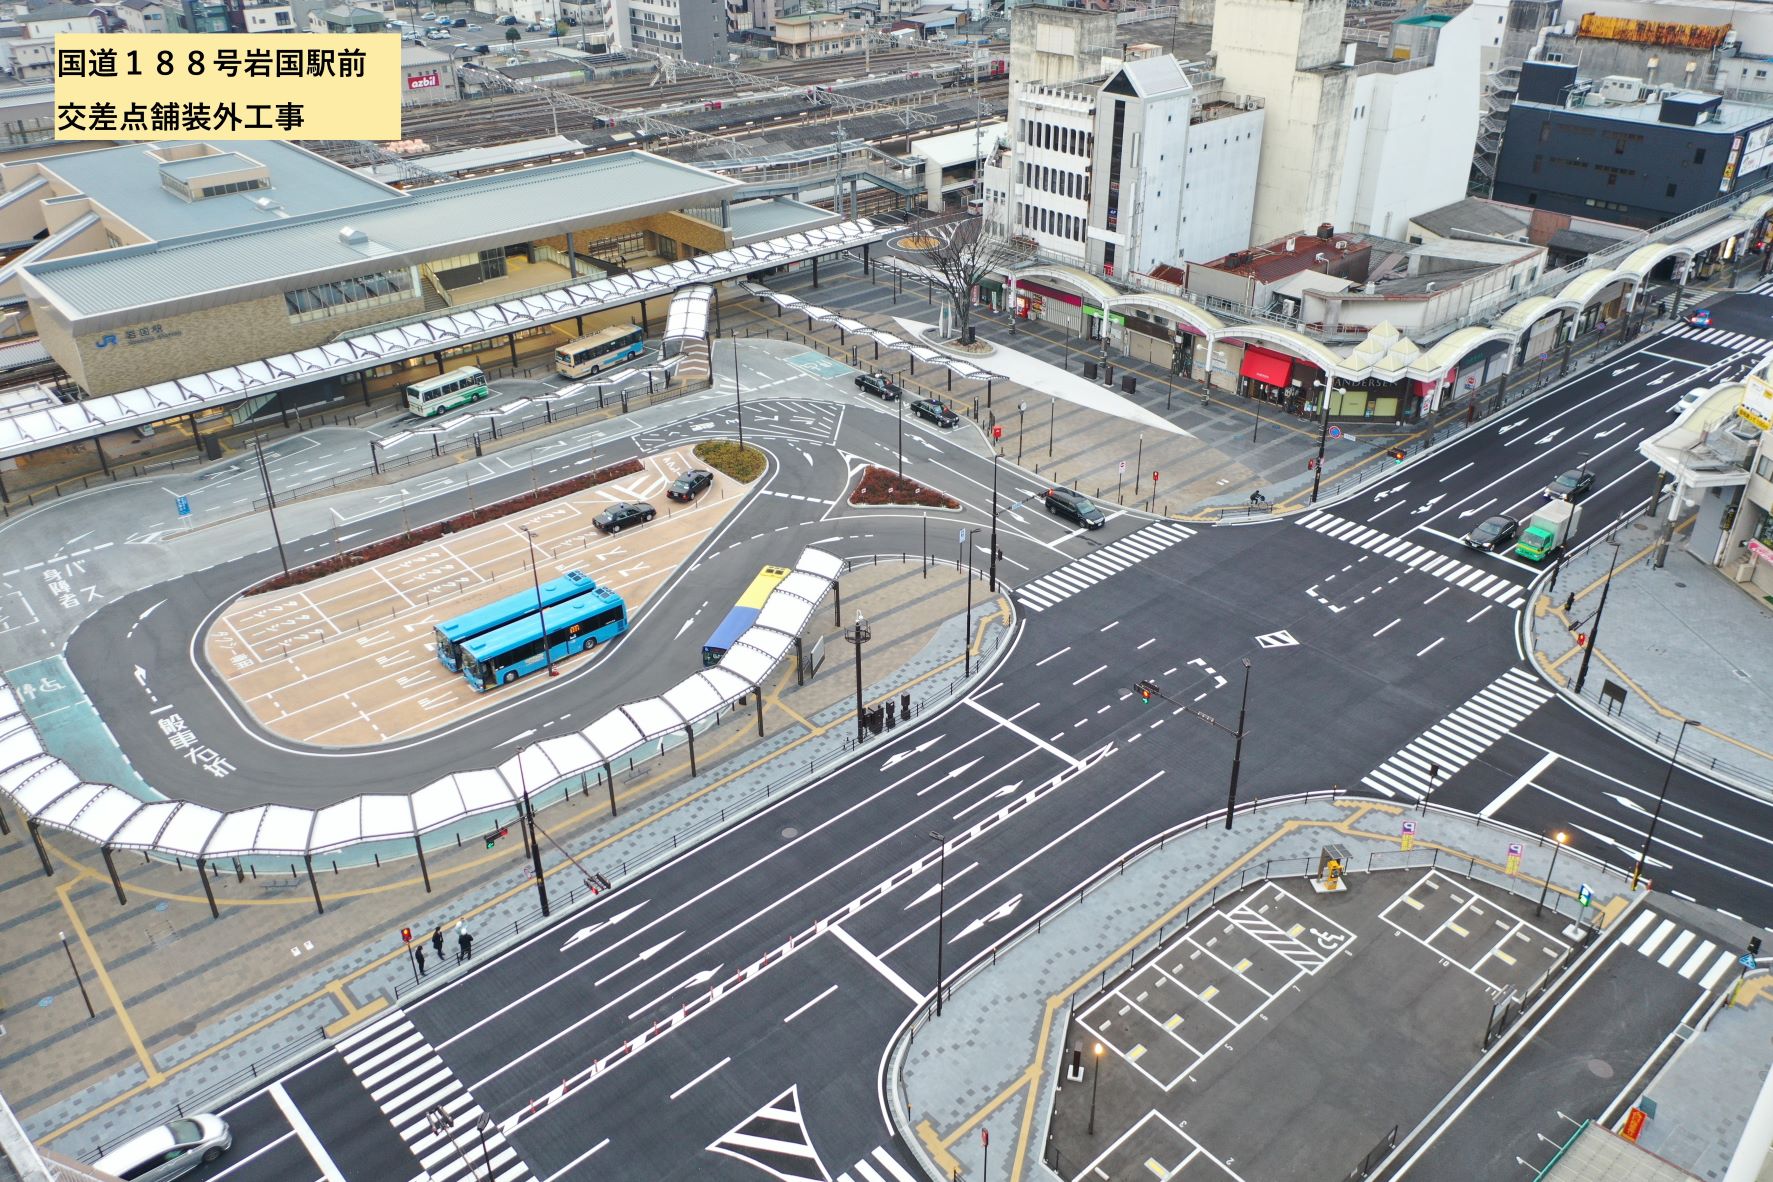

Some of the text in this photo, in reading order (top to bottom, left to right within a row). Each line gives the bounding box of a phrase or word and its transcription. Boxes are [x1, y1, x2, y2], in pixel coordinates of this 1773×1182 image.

[411, 76, 436, 88] azbil
[96, 334, 117, 348] JR
[149, 704, 238, 778] 一般車右折
[1438, 957, 1450, 967] 10
[1179, 1120, 1188, 1128] 3
[1225, 1157, 1235, 1167] 2
